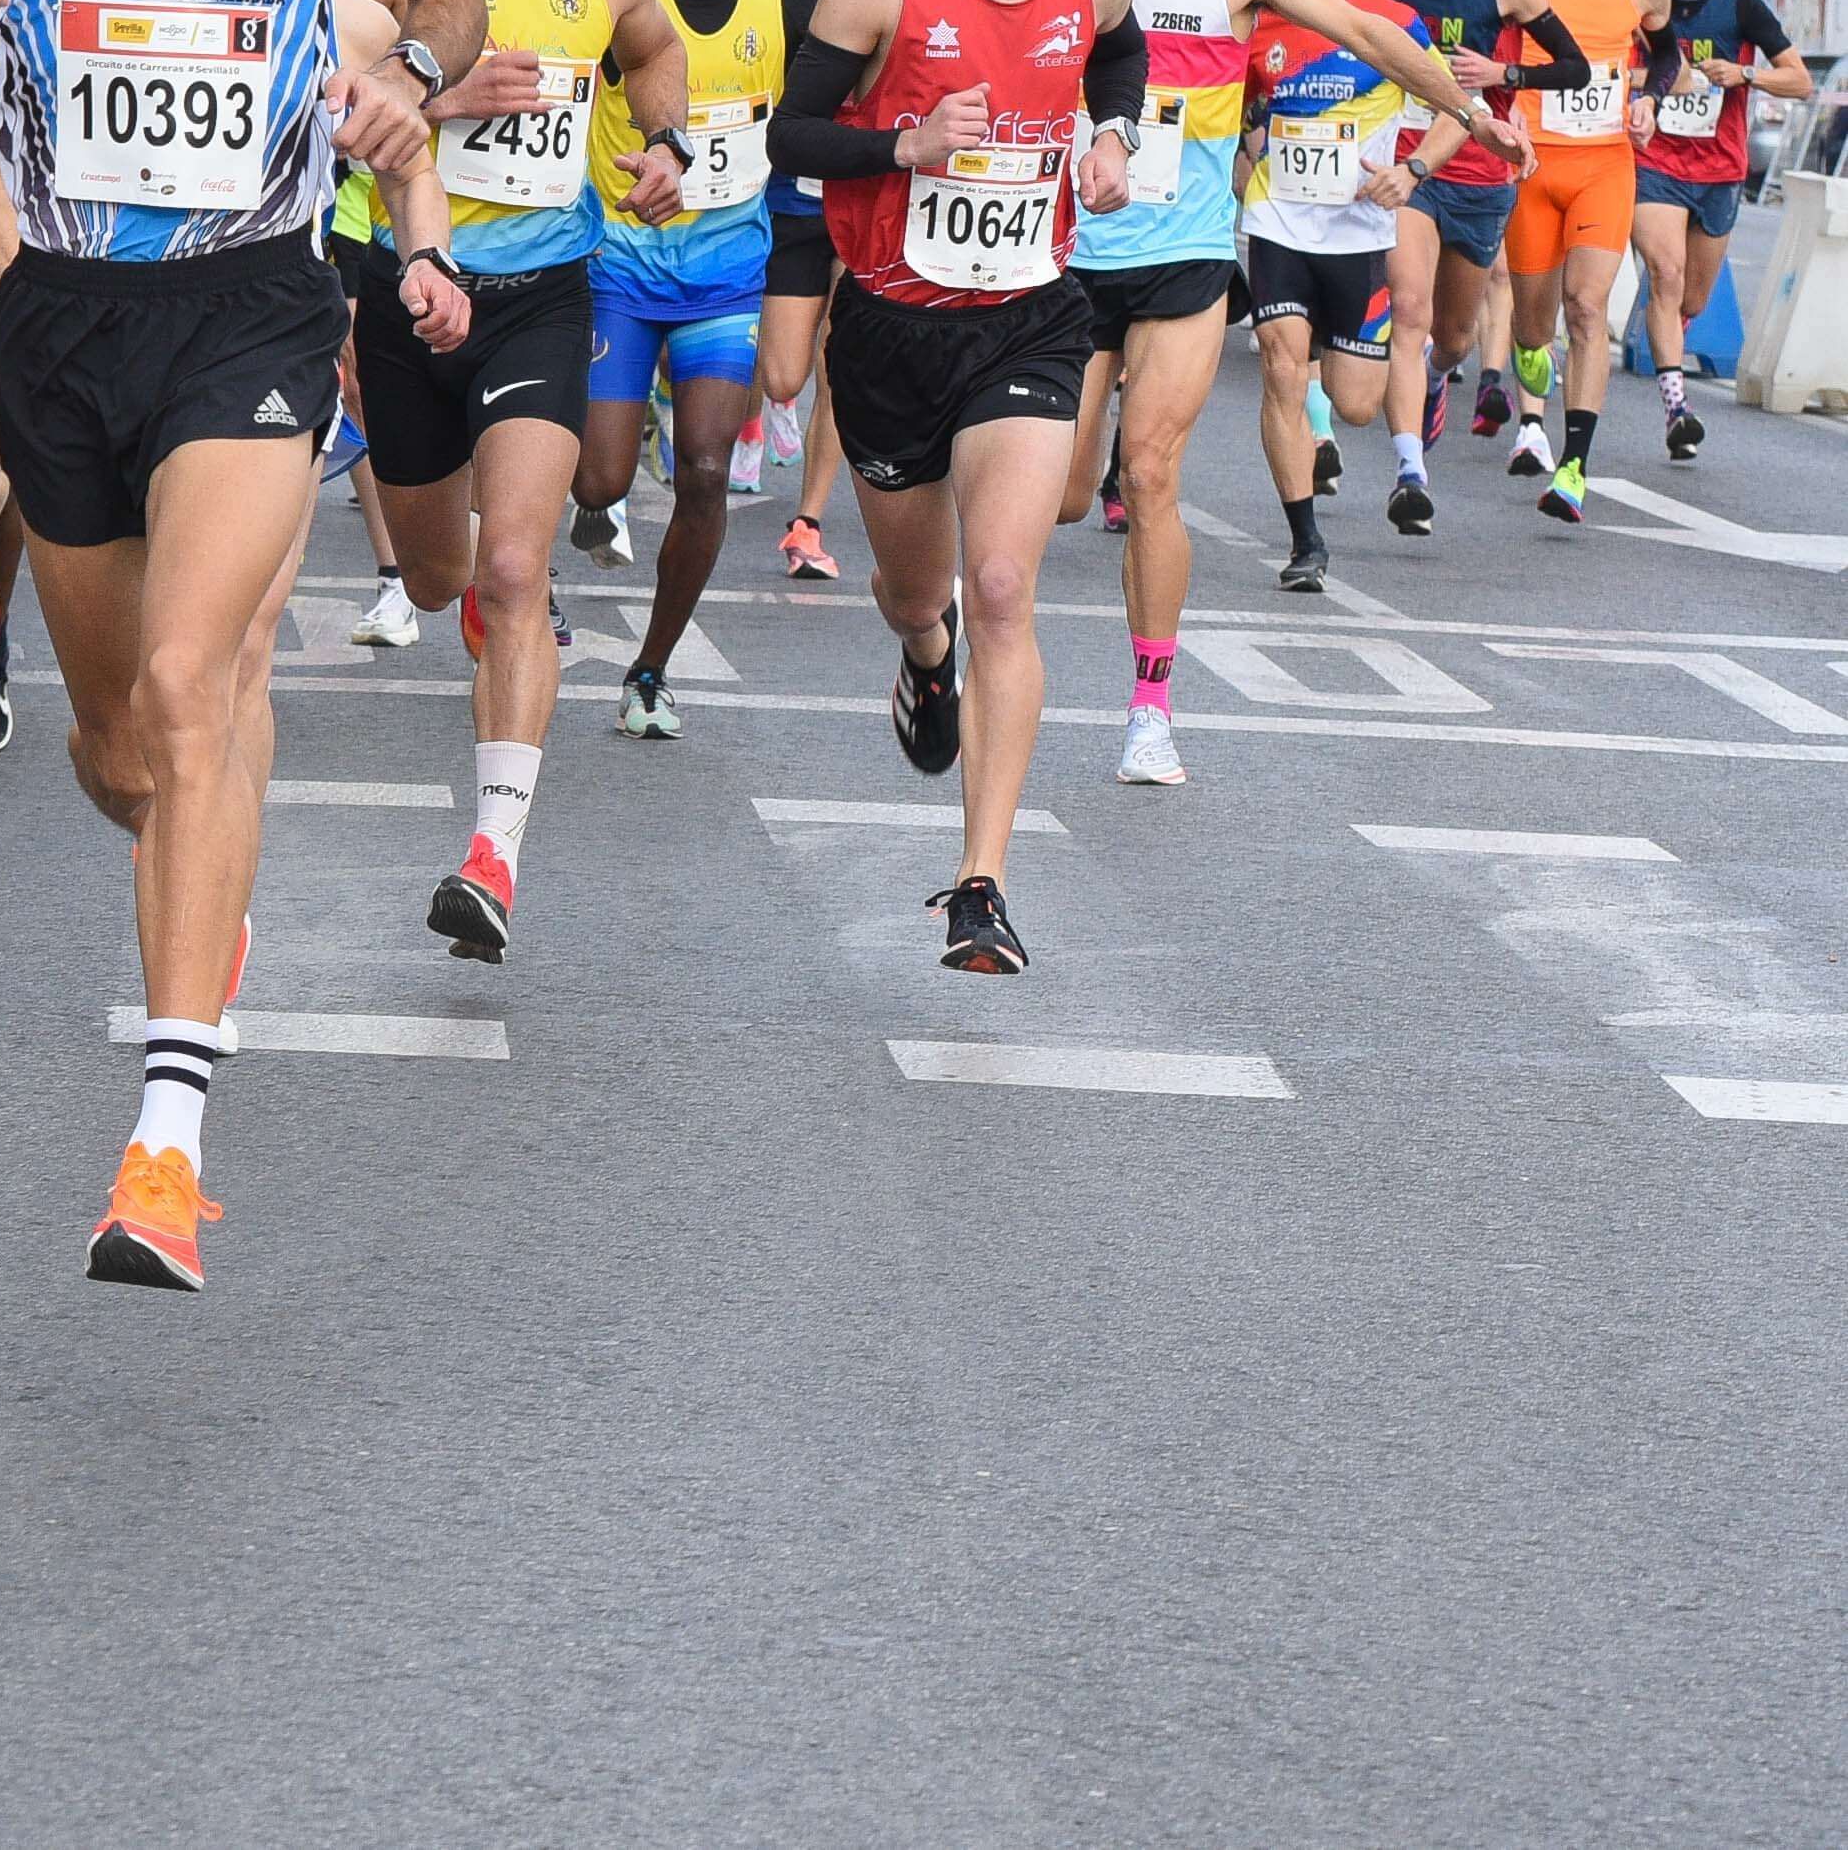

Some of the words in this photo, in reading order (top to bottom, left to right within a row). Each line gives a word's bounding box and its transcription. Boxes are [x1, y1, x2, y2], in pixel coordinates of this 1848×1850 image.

[1152, 11, 1203, 32] 226ERS
[241, 21, 258, 50] 8
[925, 48, 961, 59] luanvi
[85, 58, 122, 71] Circuito
[125, 61, 137, 71] de
[139, 62, 184, 73] Carreras
[188, 64, 240, 75] #Sevilla10
[576, 80, 584, 101] 8
[1556, 86, 1613, 114] 1567
[71, 73, 254, 150] 10393
[463, 109, 573, 160] 2436
[709, 137, 728, 173] 5
[1279, 144, 1340, 177] 1971
[935, 181, 965, 192] Circuito
[919, 191, 1049, 249] 10647
[253, 410, 298, 427] adidas
[483, 784, 529, 802] new
